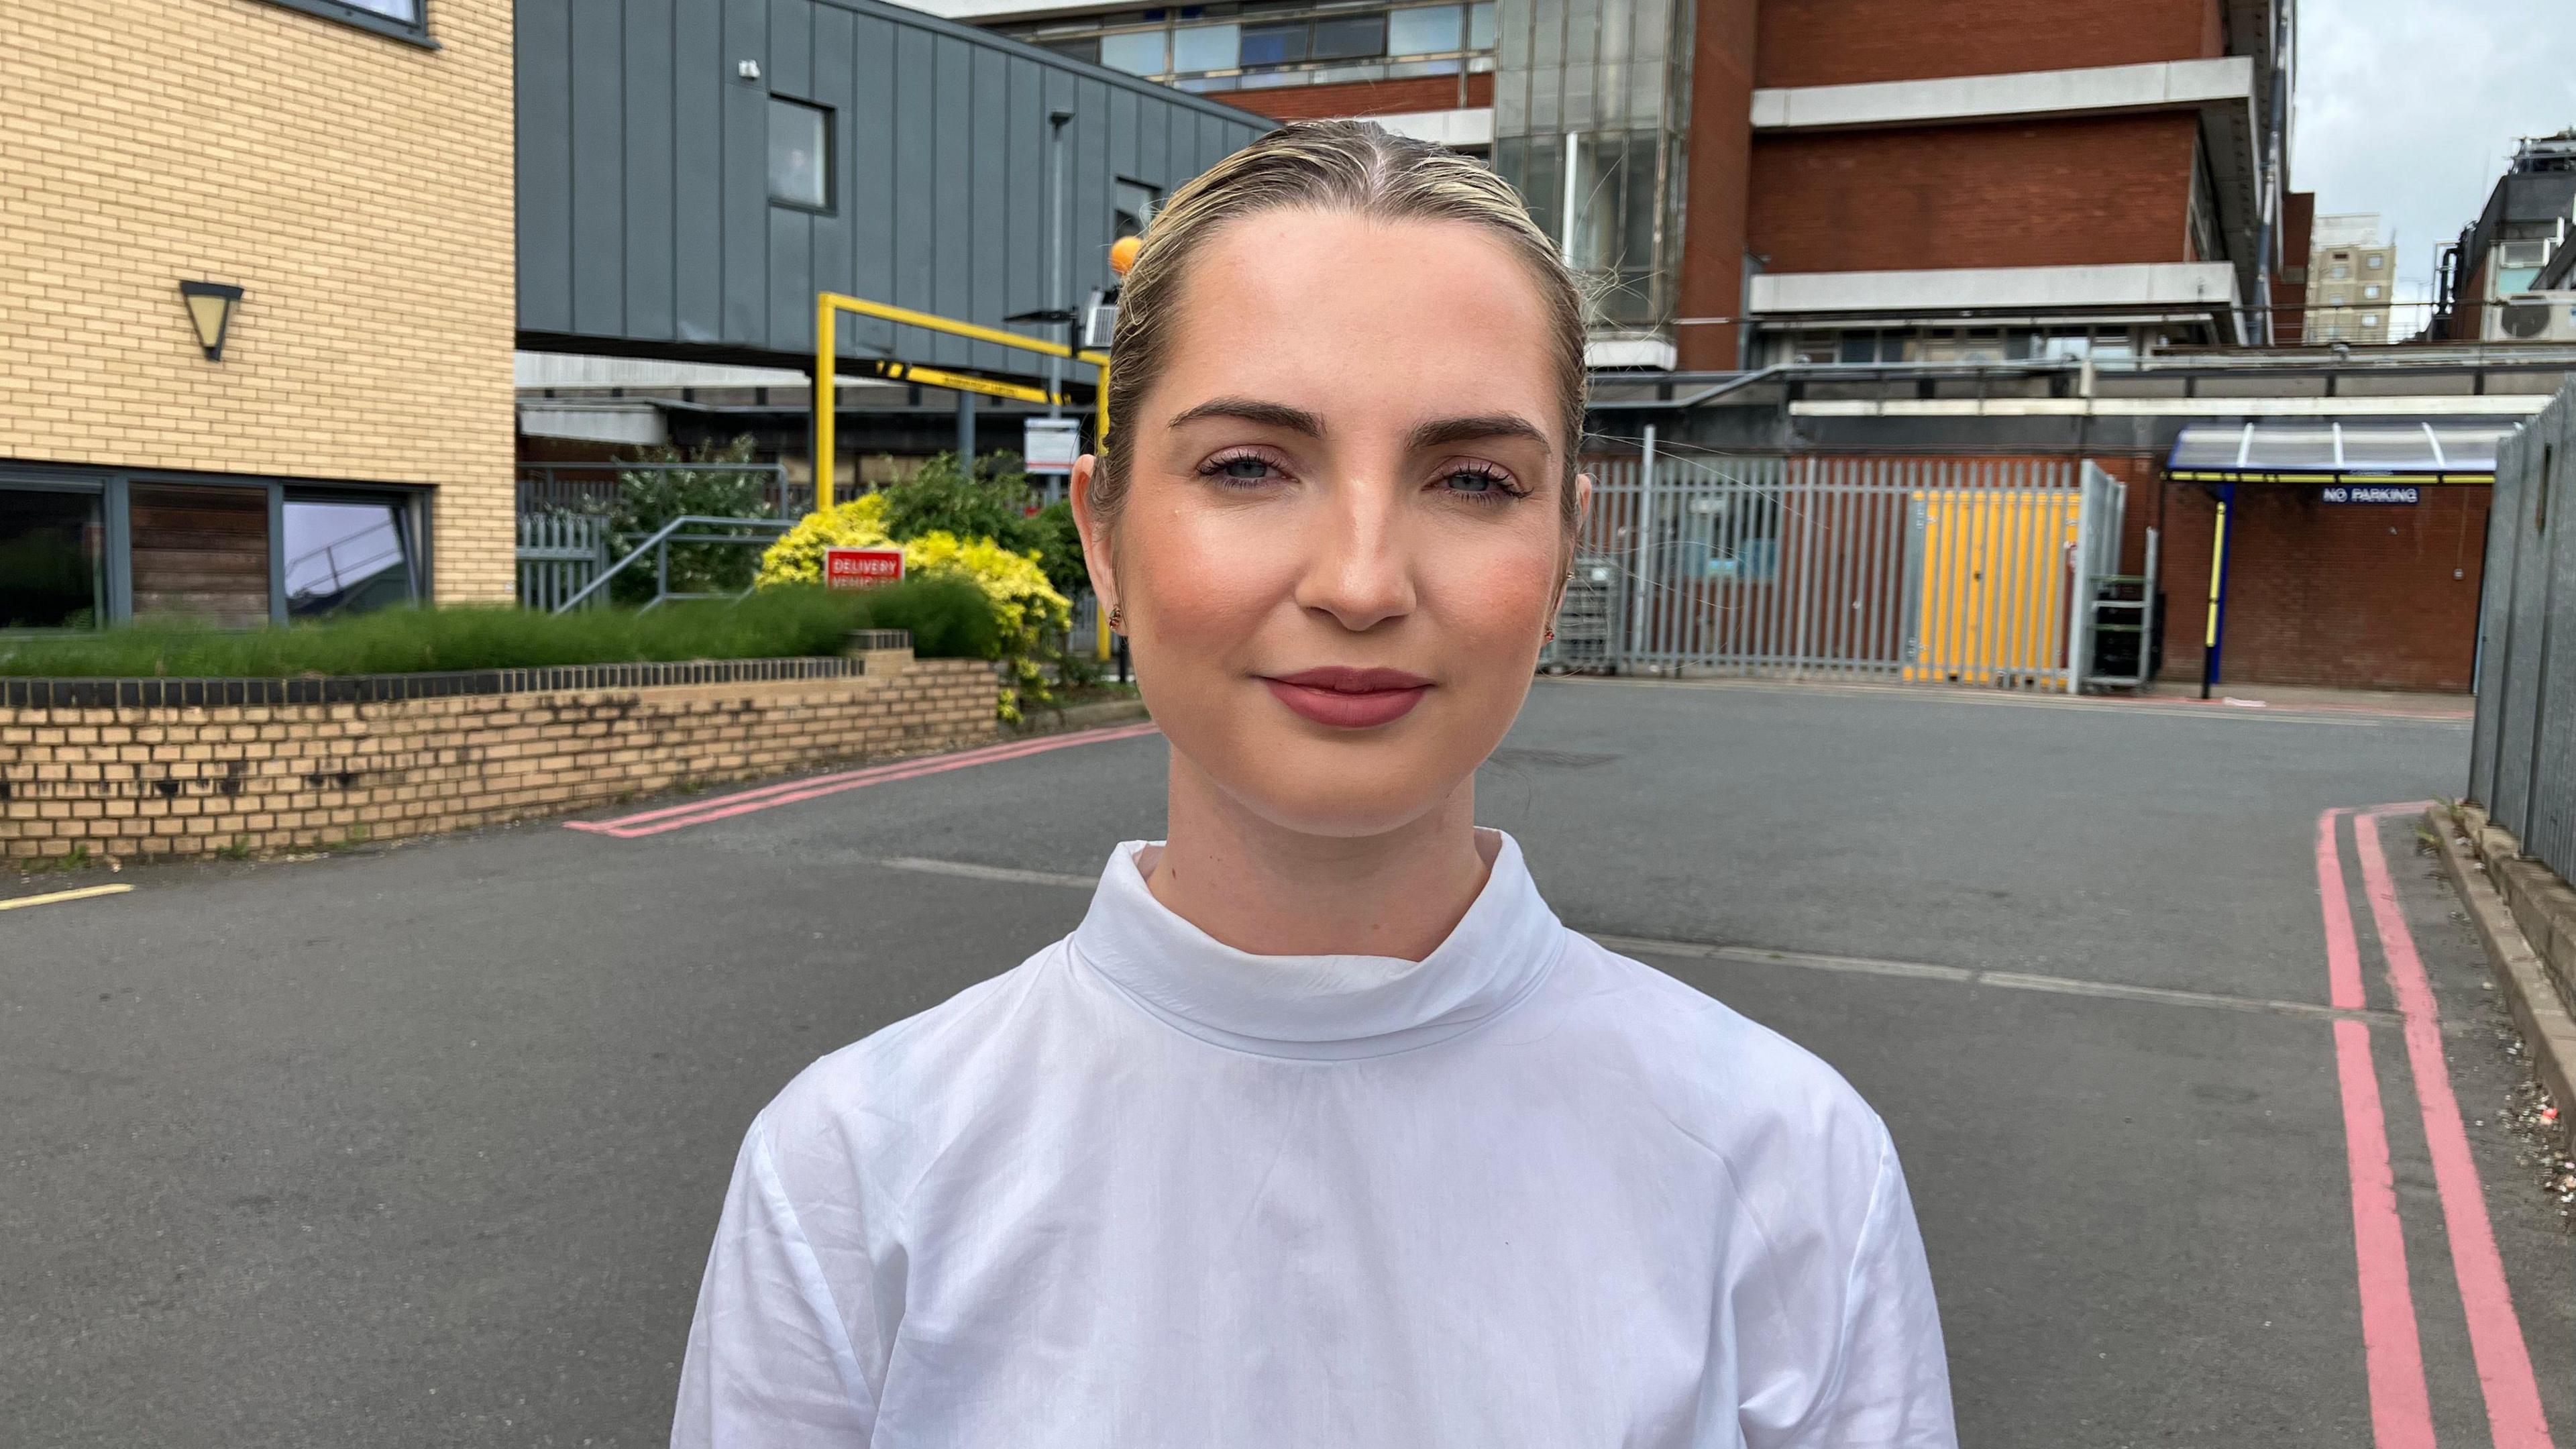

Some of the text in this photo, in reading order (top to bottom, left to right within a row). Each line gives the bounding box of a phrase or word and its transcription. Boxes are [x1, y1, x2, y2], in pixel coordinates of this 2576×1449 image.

[2323, 488, 2418, 503] NO PARKING
[833, 557, 897, 575] DELIVERY
